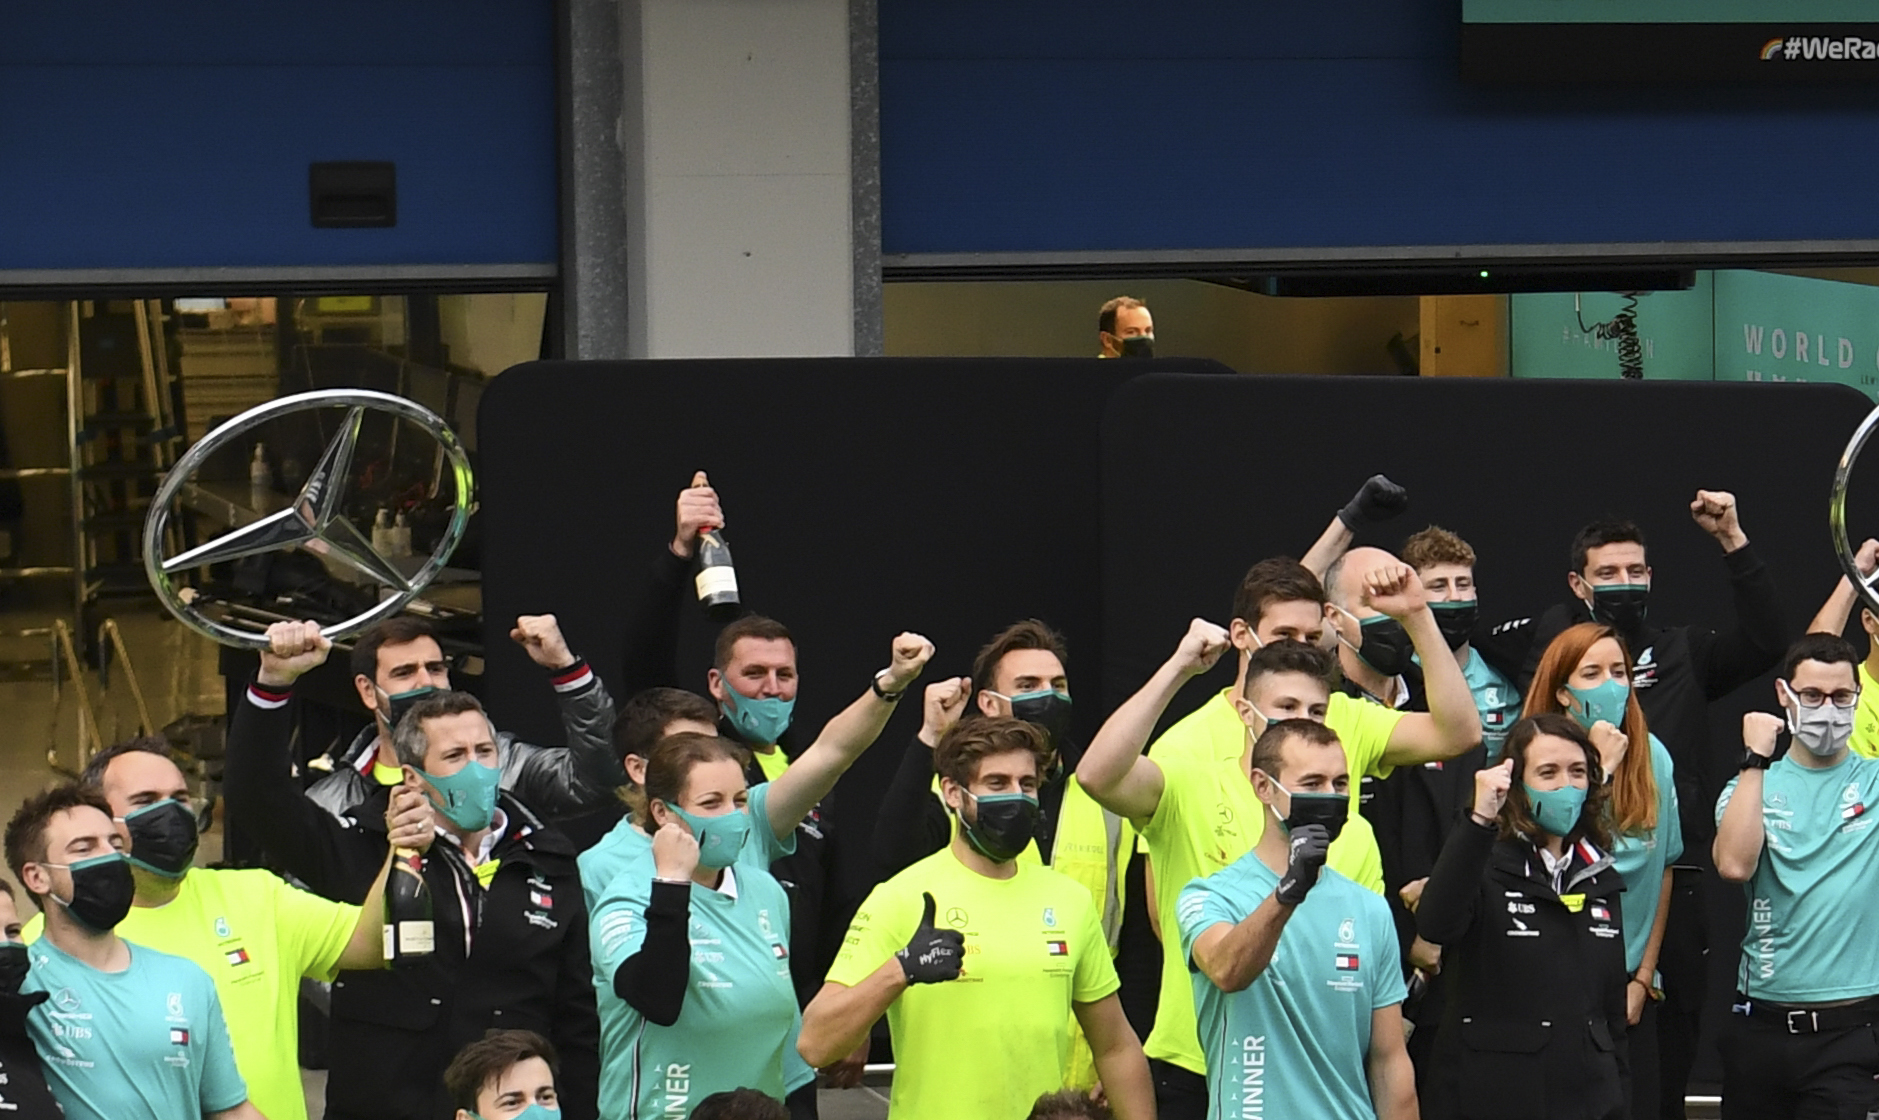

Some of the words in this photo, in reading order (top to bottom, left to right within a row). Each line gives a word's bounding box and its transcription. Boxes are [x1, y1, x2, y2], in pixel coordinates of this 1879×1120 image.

[1744, 324, 1854, 368] WORLD
[1517, 901, 1536, 913] UBS
[1754, 897, 1775, 979] WINNER
[66, 1024, 92, 1039] UBS
